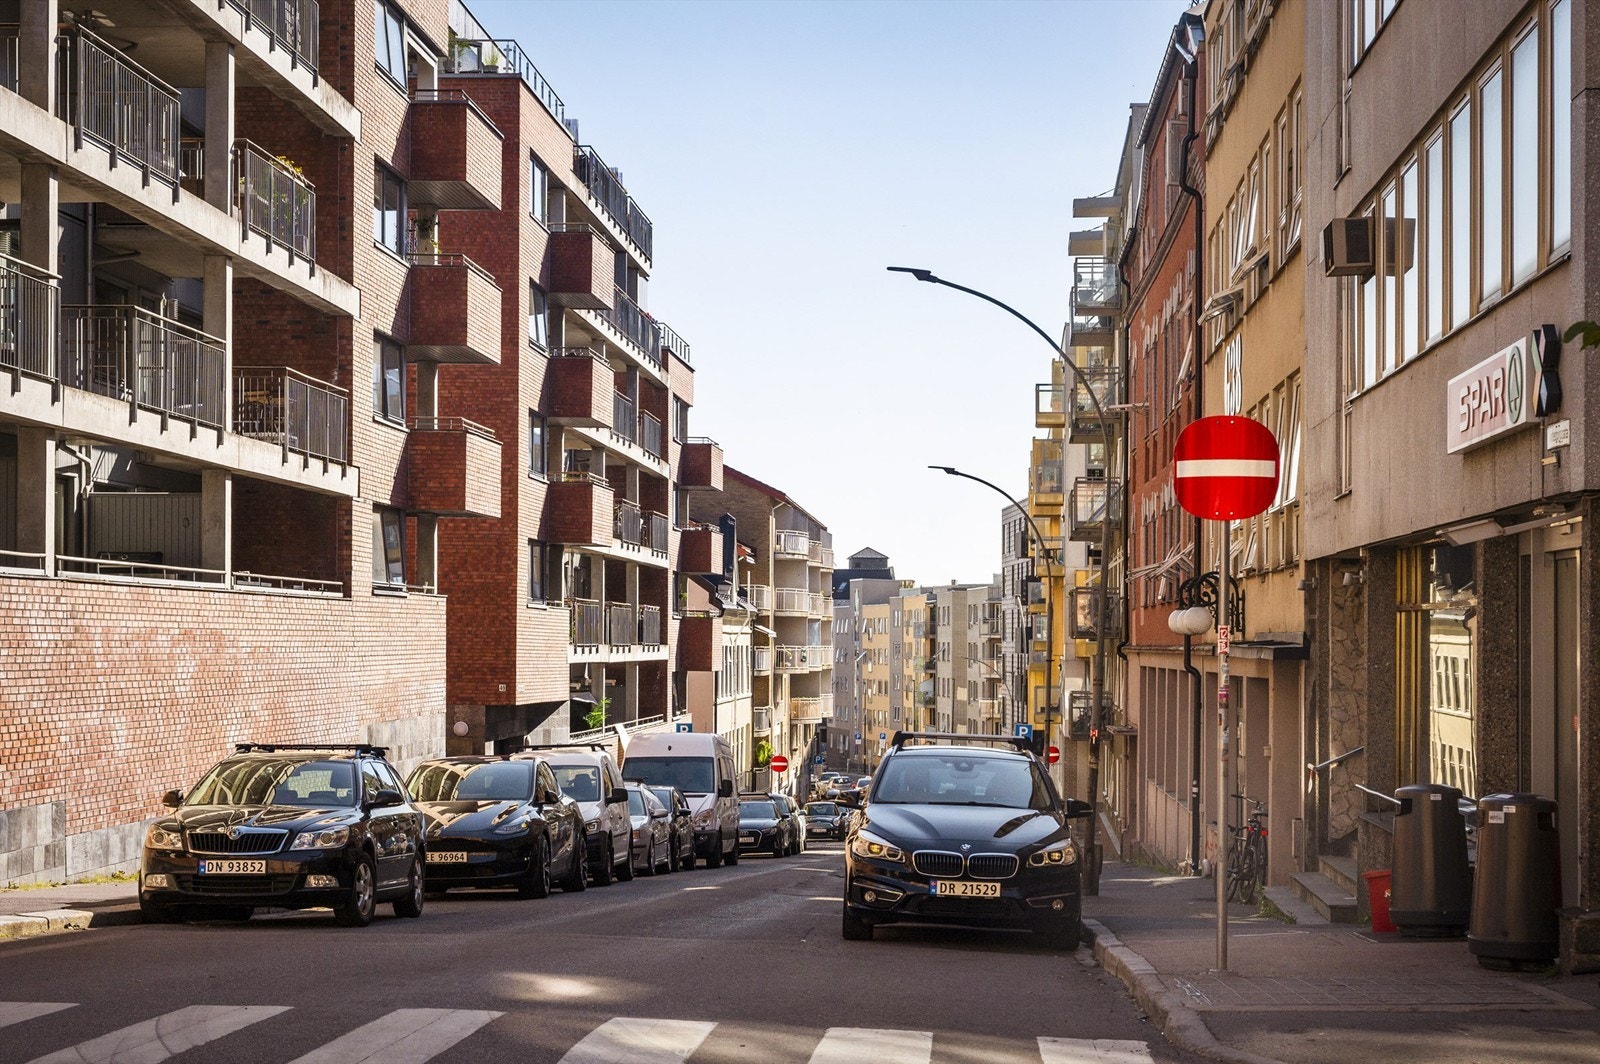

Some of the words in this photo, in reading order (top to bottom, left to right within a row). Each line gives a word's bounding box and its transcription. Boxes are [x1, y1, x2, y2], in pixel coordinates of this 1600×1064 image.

[1460, 367, 1506, 433] SPAR
[1020, 726, 1029, 737] P
[438, 853, 465, 861] 96964
[207, 862, 223, 872] DN
[228, 862, 263, 872] 93852
[940, 882, 955, 894] DR
[961, 884, 997, 895] 21529
